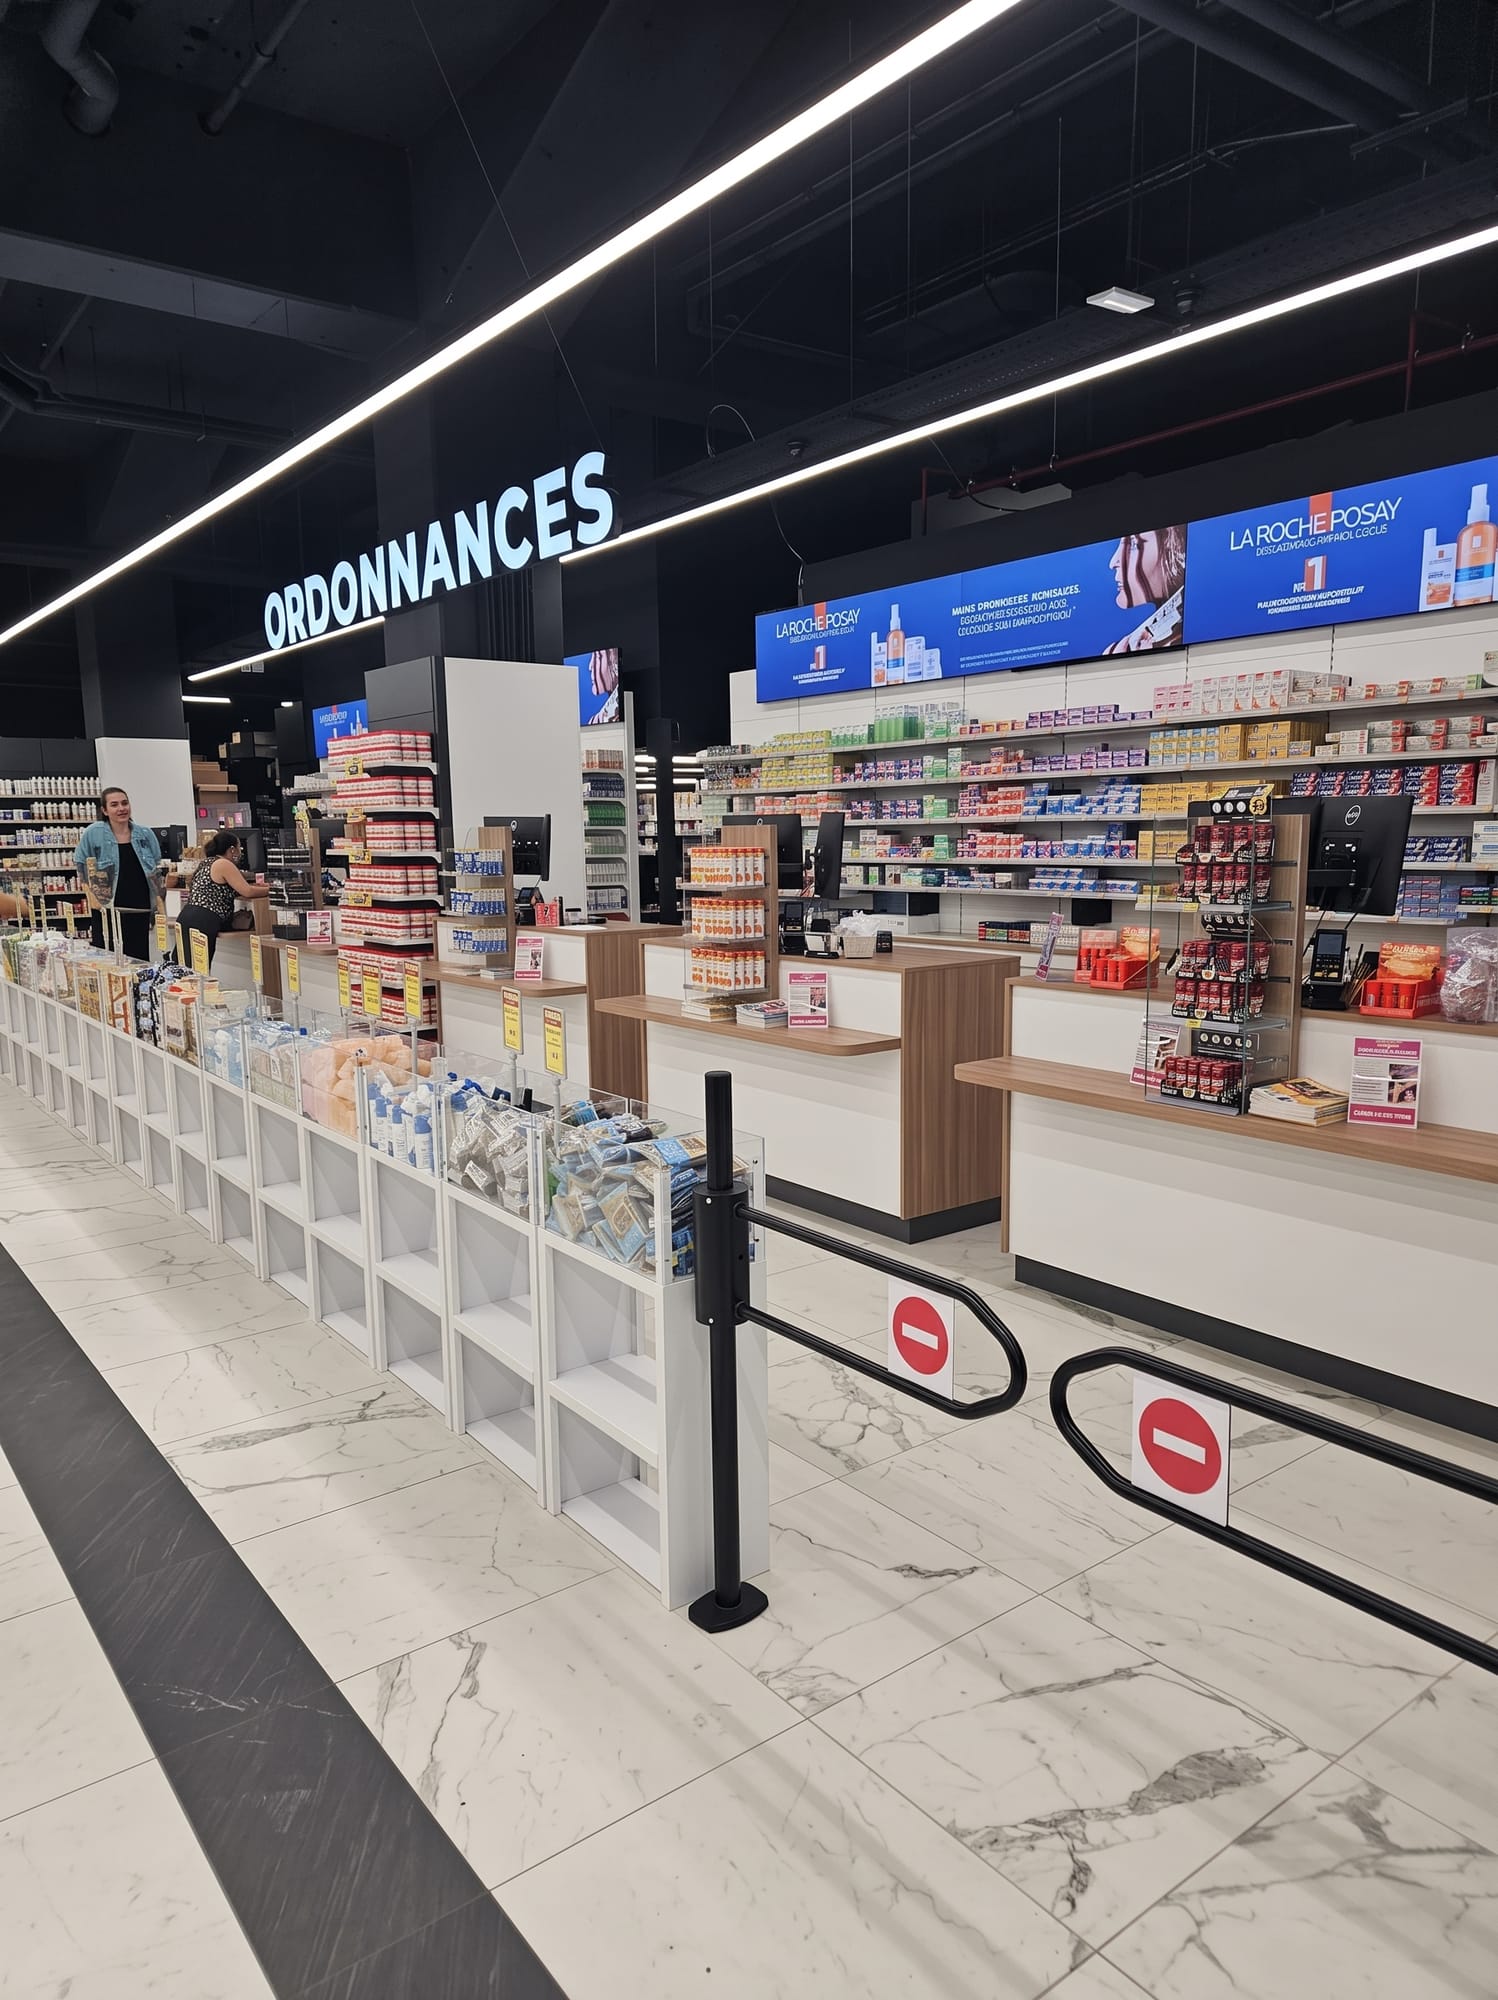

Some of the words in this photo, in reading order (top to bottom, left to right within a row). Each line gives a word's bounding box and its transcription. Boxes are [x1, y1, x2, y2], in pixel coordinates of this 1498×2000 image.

[264, 451, 615, 650] ORDONNANCES
[1230, 528, 1254, 551] LA
[1257, 512, 1327, 546] ROCHE
[1330, 496, 1403, 532] POSAY
[776, 622, 790, 639] LA
[789, 616, 825, 636] ROCHE
[825, 607, 861, 630] POSAY
